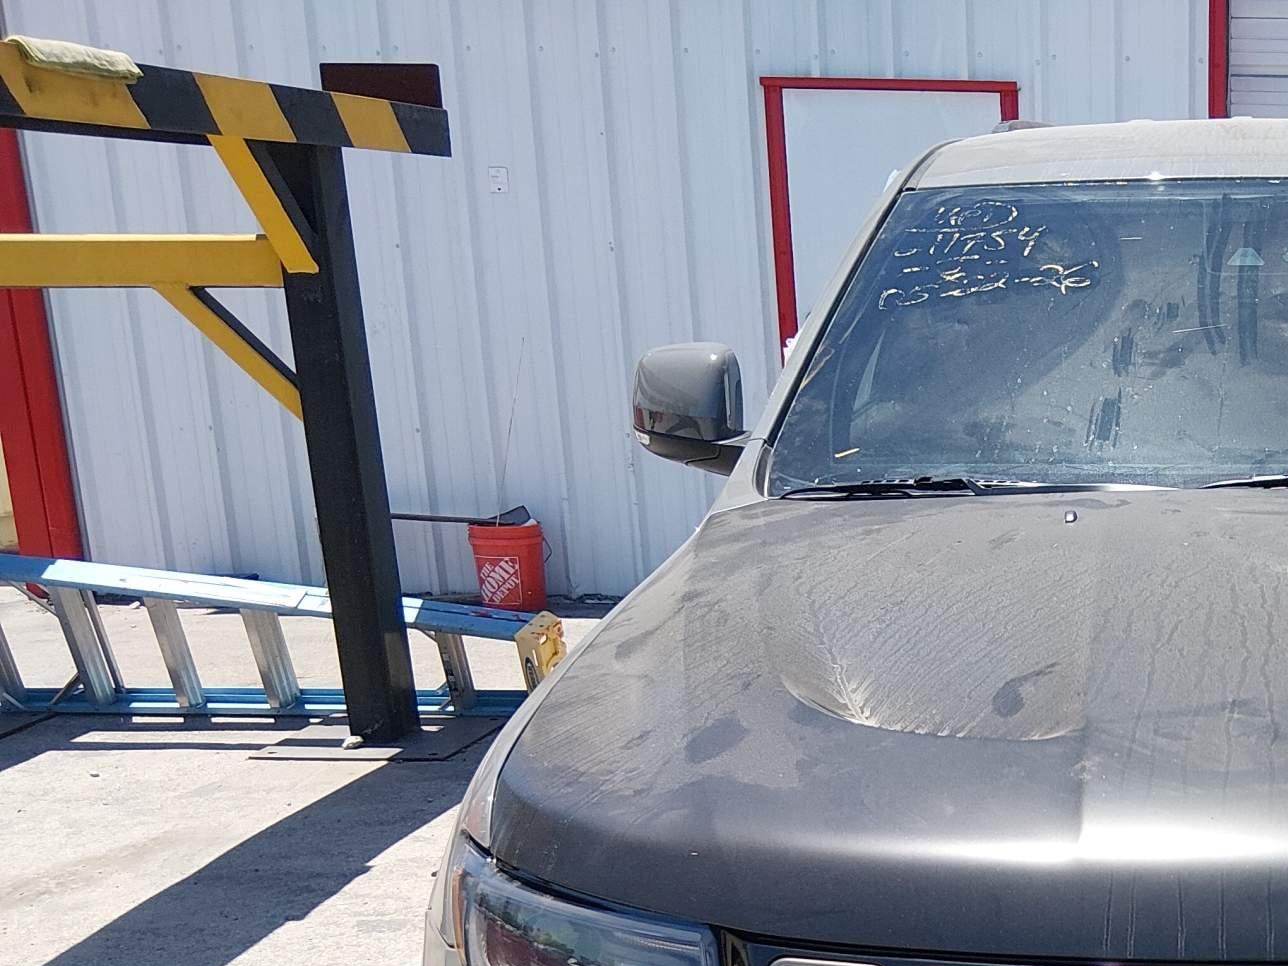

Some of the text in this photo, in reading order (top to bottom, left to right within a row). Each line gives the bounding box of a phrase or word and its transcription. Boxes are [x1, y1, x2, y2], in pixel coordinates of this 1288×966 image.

[479, 561, 495, 580] THE
[480, 557, 519, 603] HOME
[492, 574, 520, 604] DEPOT
